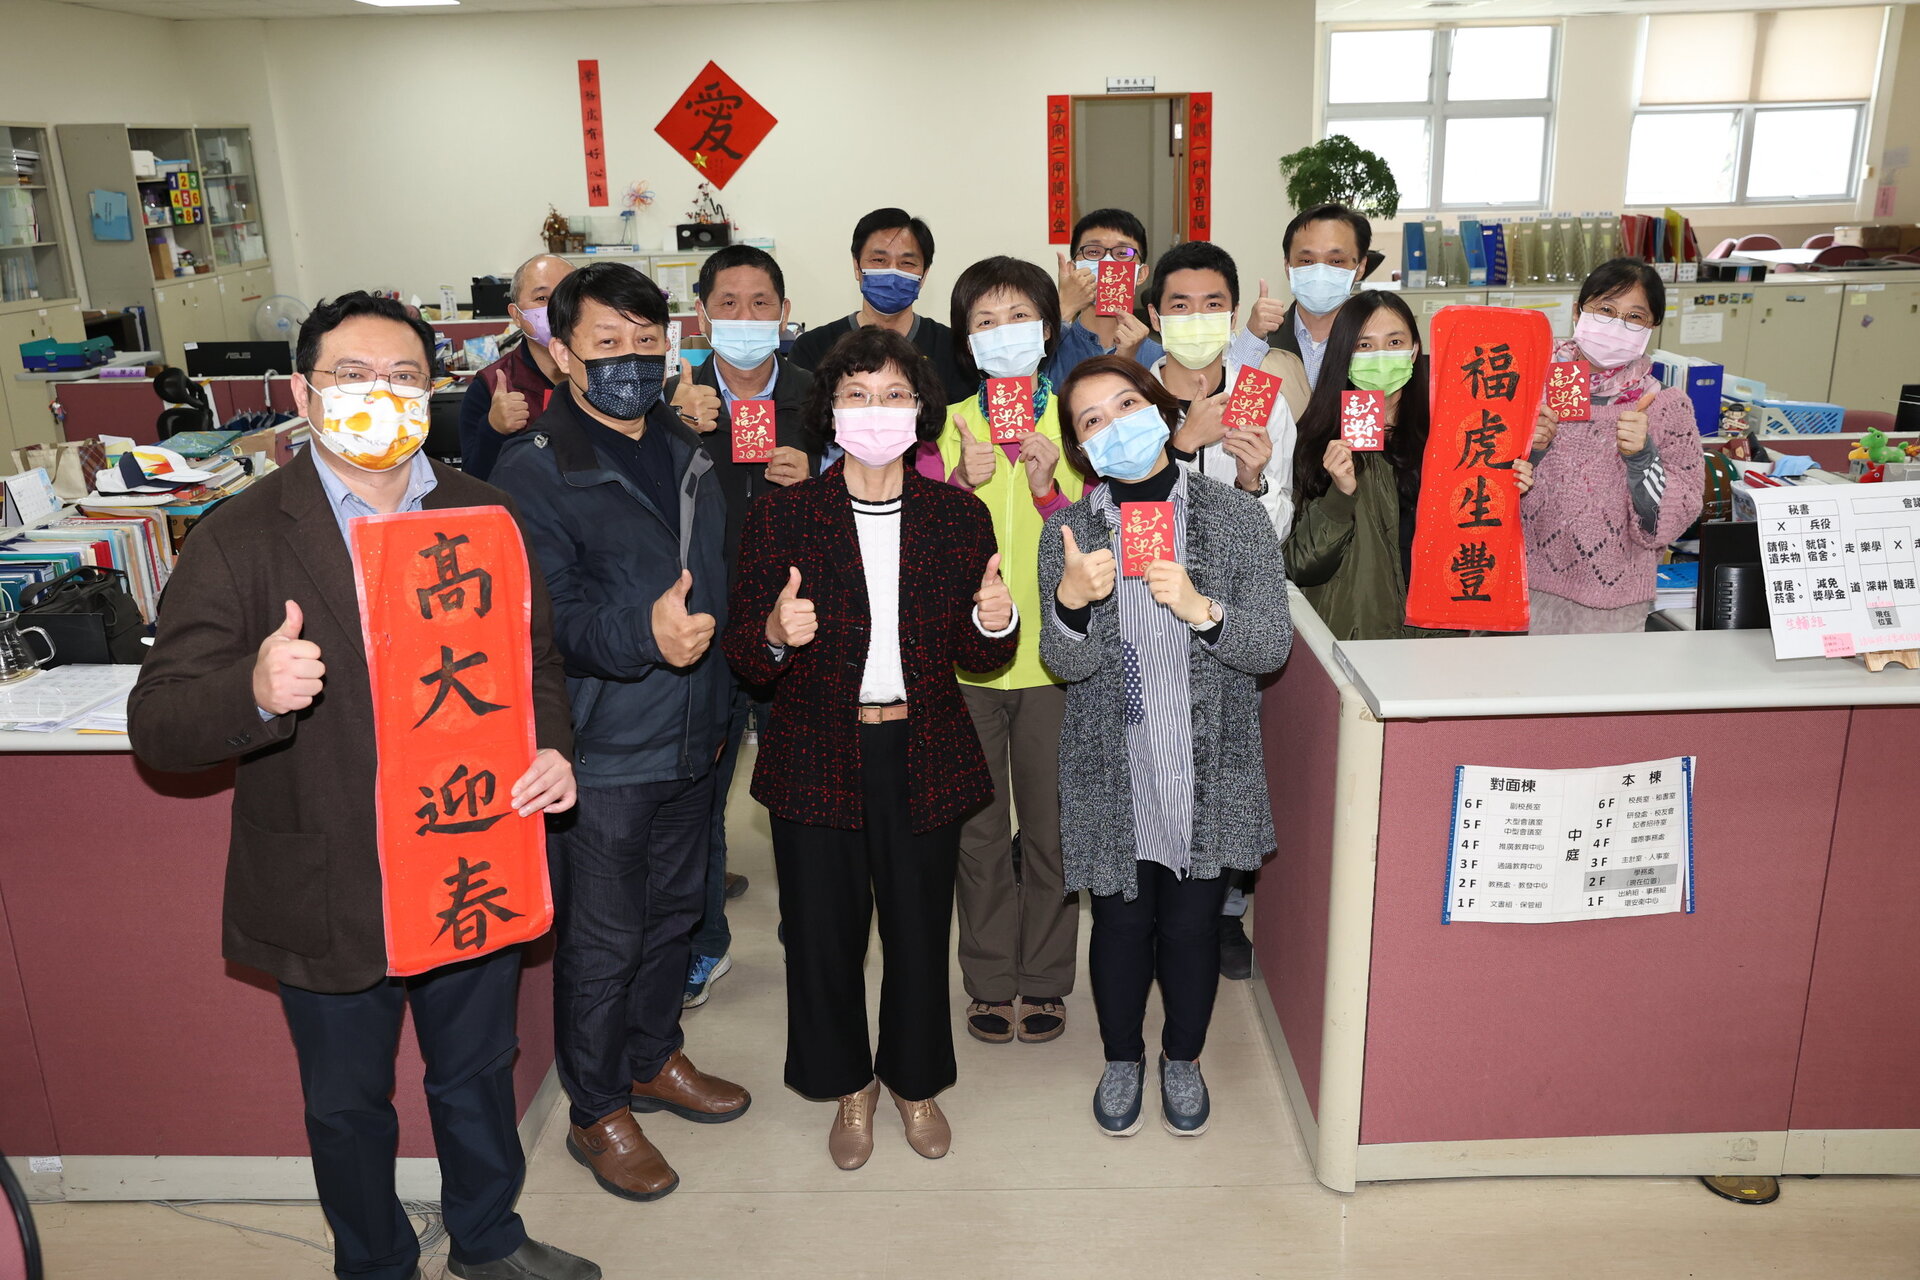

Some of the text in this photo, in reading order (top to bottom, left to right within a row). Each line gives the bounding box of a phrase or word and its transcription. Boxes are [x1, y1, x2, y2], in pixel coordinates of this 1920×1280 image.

[684, 81, 744, 160] 愛
[170, 175, 197, 188] 1 2 3
[173, 192, 199, 205] 4 5 6
[185, 210, 192, 222] 8
[1450, 343, 1522, 602] 福虎生豐
[1788, 504, 1810, 515] 秘書
[1810, 518, 1831, 530] 兵役
[1860, 540, 1882, 553] 樂學
[1769, 552, 1801, 564] 遺失物
[1816, 577, 1839, 589] 減免
[1866, 580, 1888, 592] 深耕
[1893, 578, 1916, 590] 職涯
[1813, 588, 1846, 601] 獎學金
[1875, 610, 1891, 618] 現在
[1878, 618, 1893, 626] 位置
[410, 532, 527, 951] 高大迎春
[1489, 777, 1537, 793] 對面棟
[1509, 802, 1542, 811] 副校長室
[1504, 818, 1544, 826] 大型會議室
[1503, 828, 1543, 836] 中型會議室
[1630, 833, 1666, 844] 國際事務處
[1498, 843, 1545, 851] 推廣教育中心
[1565, 828, 1582, 862] 中庭
[1497, 862, 1543, 870] 通識教育中心
[1633, 867, 1655, 876] 學務處
